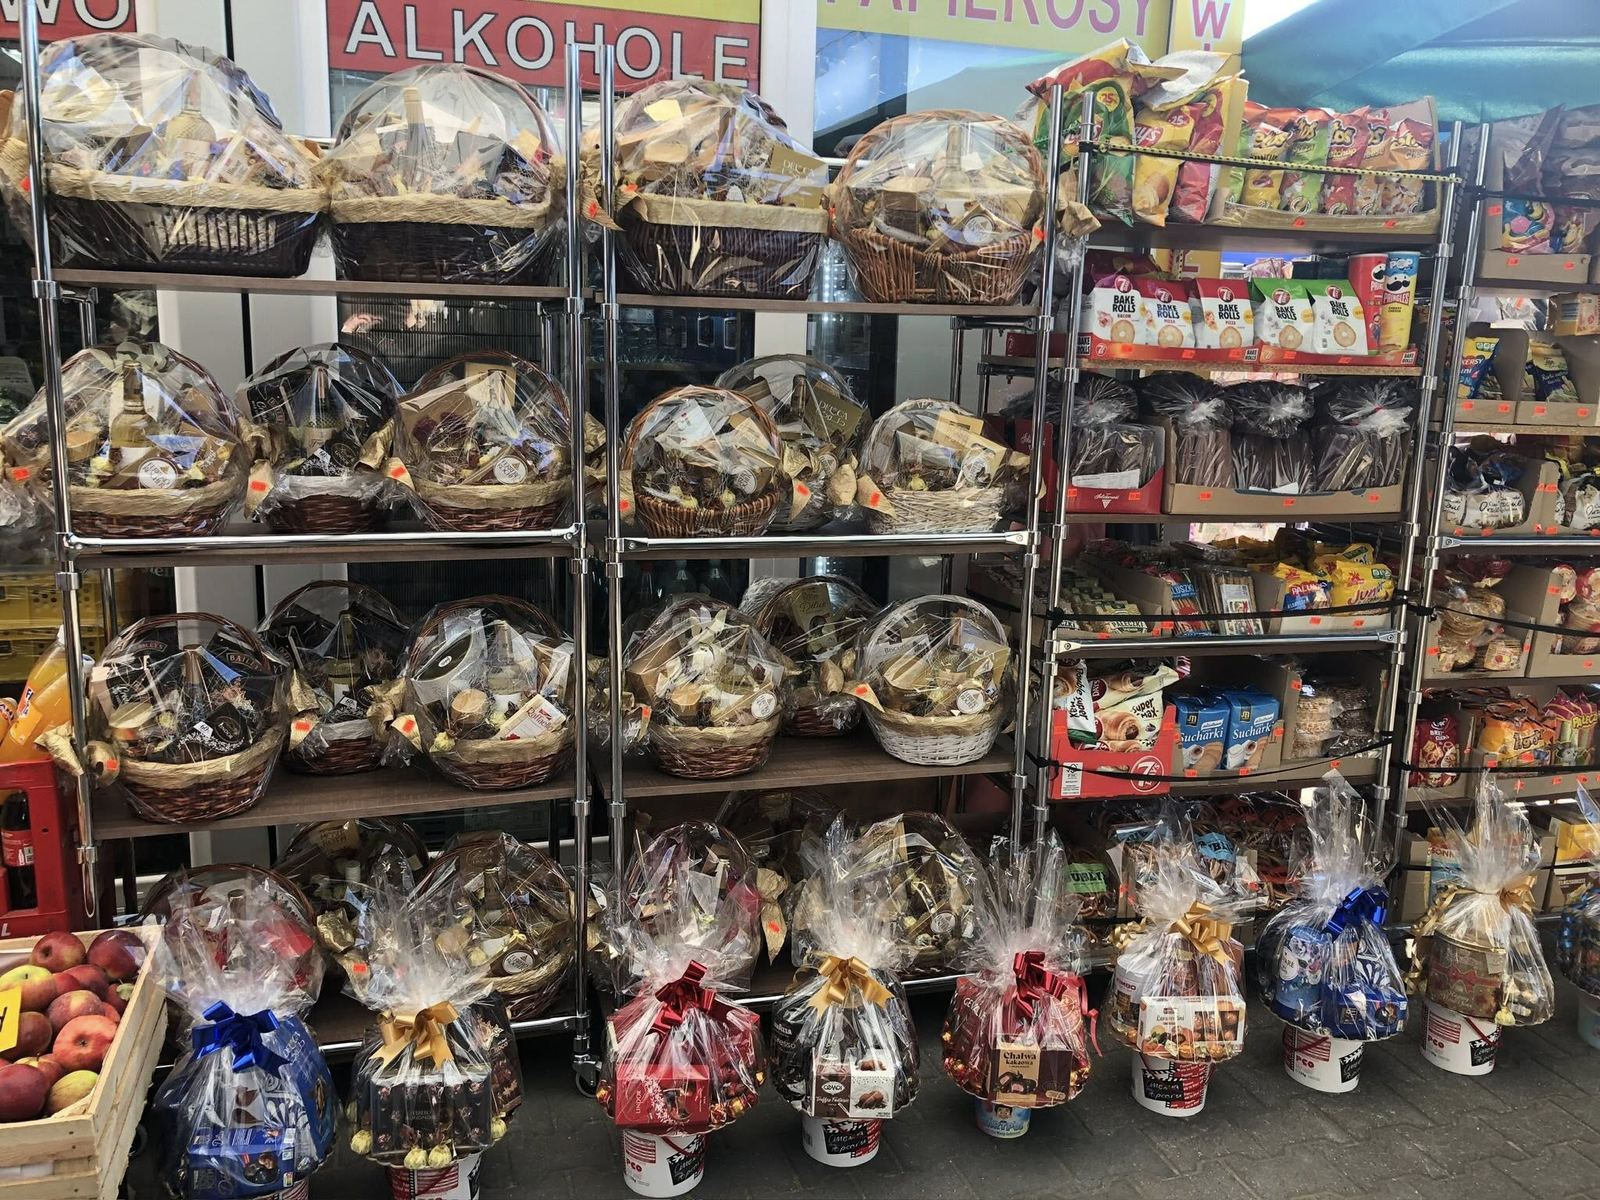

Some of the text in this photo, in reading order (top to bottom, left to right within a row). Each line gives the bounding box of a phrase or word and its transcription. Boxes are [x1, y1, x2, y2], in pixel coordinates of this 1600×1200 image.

[342, 0, 749, 88] ALKOHOLE
[1113, 294, 1135, 305] BAKE
[1112, 303, 1136, 313] ROLLS
[1156, 303, 1177, 313] BAKE
[1218, 304, 1239, 313] BAKE
[1275, 305, 1295, 315] BAKE
[1329, 300, 1347, 311] BAKE
[1157, 310, 1180, 320] ROLLS
[1218, 311, 1241, 320] ROLLS
[1276, 311, 1297, 321] ROLLS
[1331, 307, 1350, 318] ROLLS
